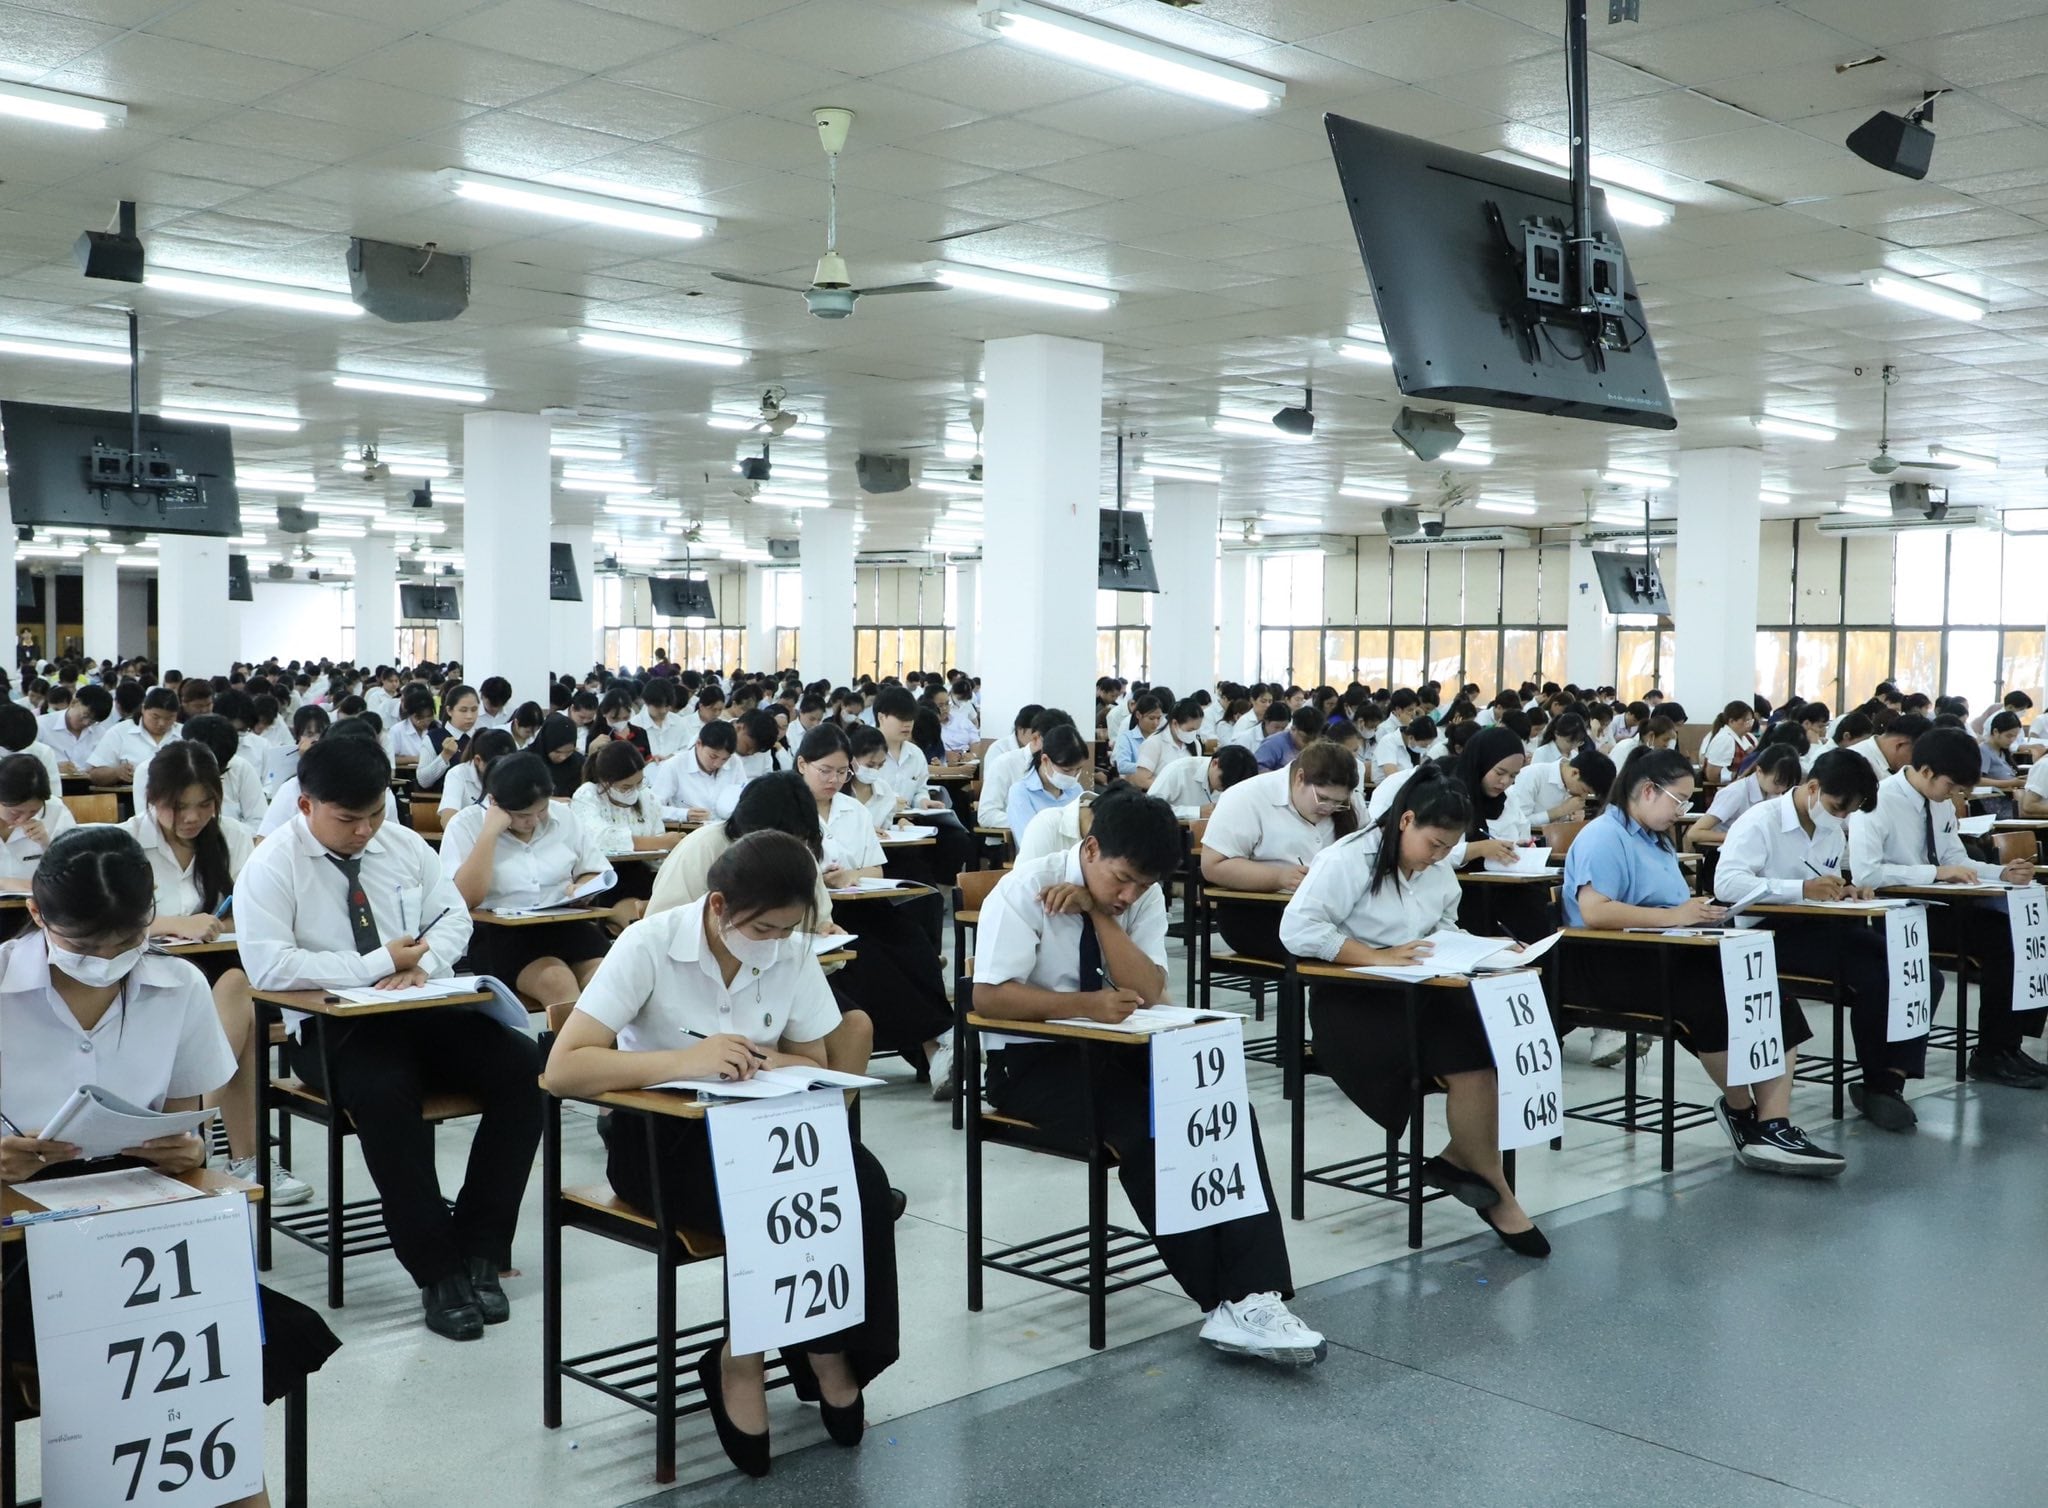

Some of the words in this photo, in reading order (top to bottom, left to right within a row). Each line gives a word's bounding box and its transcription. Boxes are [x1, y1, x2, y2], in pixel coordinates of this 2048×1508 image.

[2025, 902, 2040, 927] 15
[1903, 922, 1919, 949] 16
[2025, 935, 2047, 961] 505
[1744, 950, 1764, 982] 17
[1903, 958, 1926, 988] 541
[1506, 993, 1535, 1027] 18
[1744, 990, 1773, 1025] 577
[1906, 999, 1928, 1029] 576
[1192, 1046, 1226, 1091] 19
[1515, 1038, 1553, 1076] 613
[1749, 1036, 1780, 1071] 612
[1187, 1099, 1239, 1148] 649
[1523, 1091, 1558, 1131] 648
[768, 1120, 820, 1174] 20
[1190, 1161, 1247, 1212] 684
[766, 1185, 842, 1245] 685
[120, 1238, 202, 1309] 21
[774, 1263, 850, 1324] 720
[106, 1320, 231, 1401] 721
[112, 1417, 237, 1502] 756
